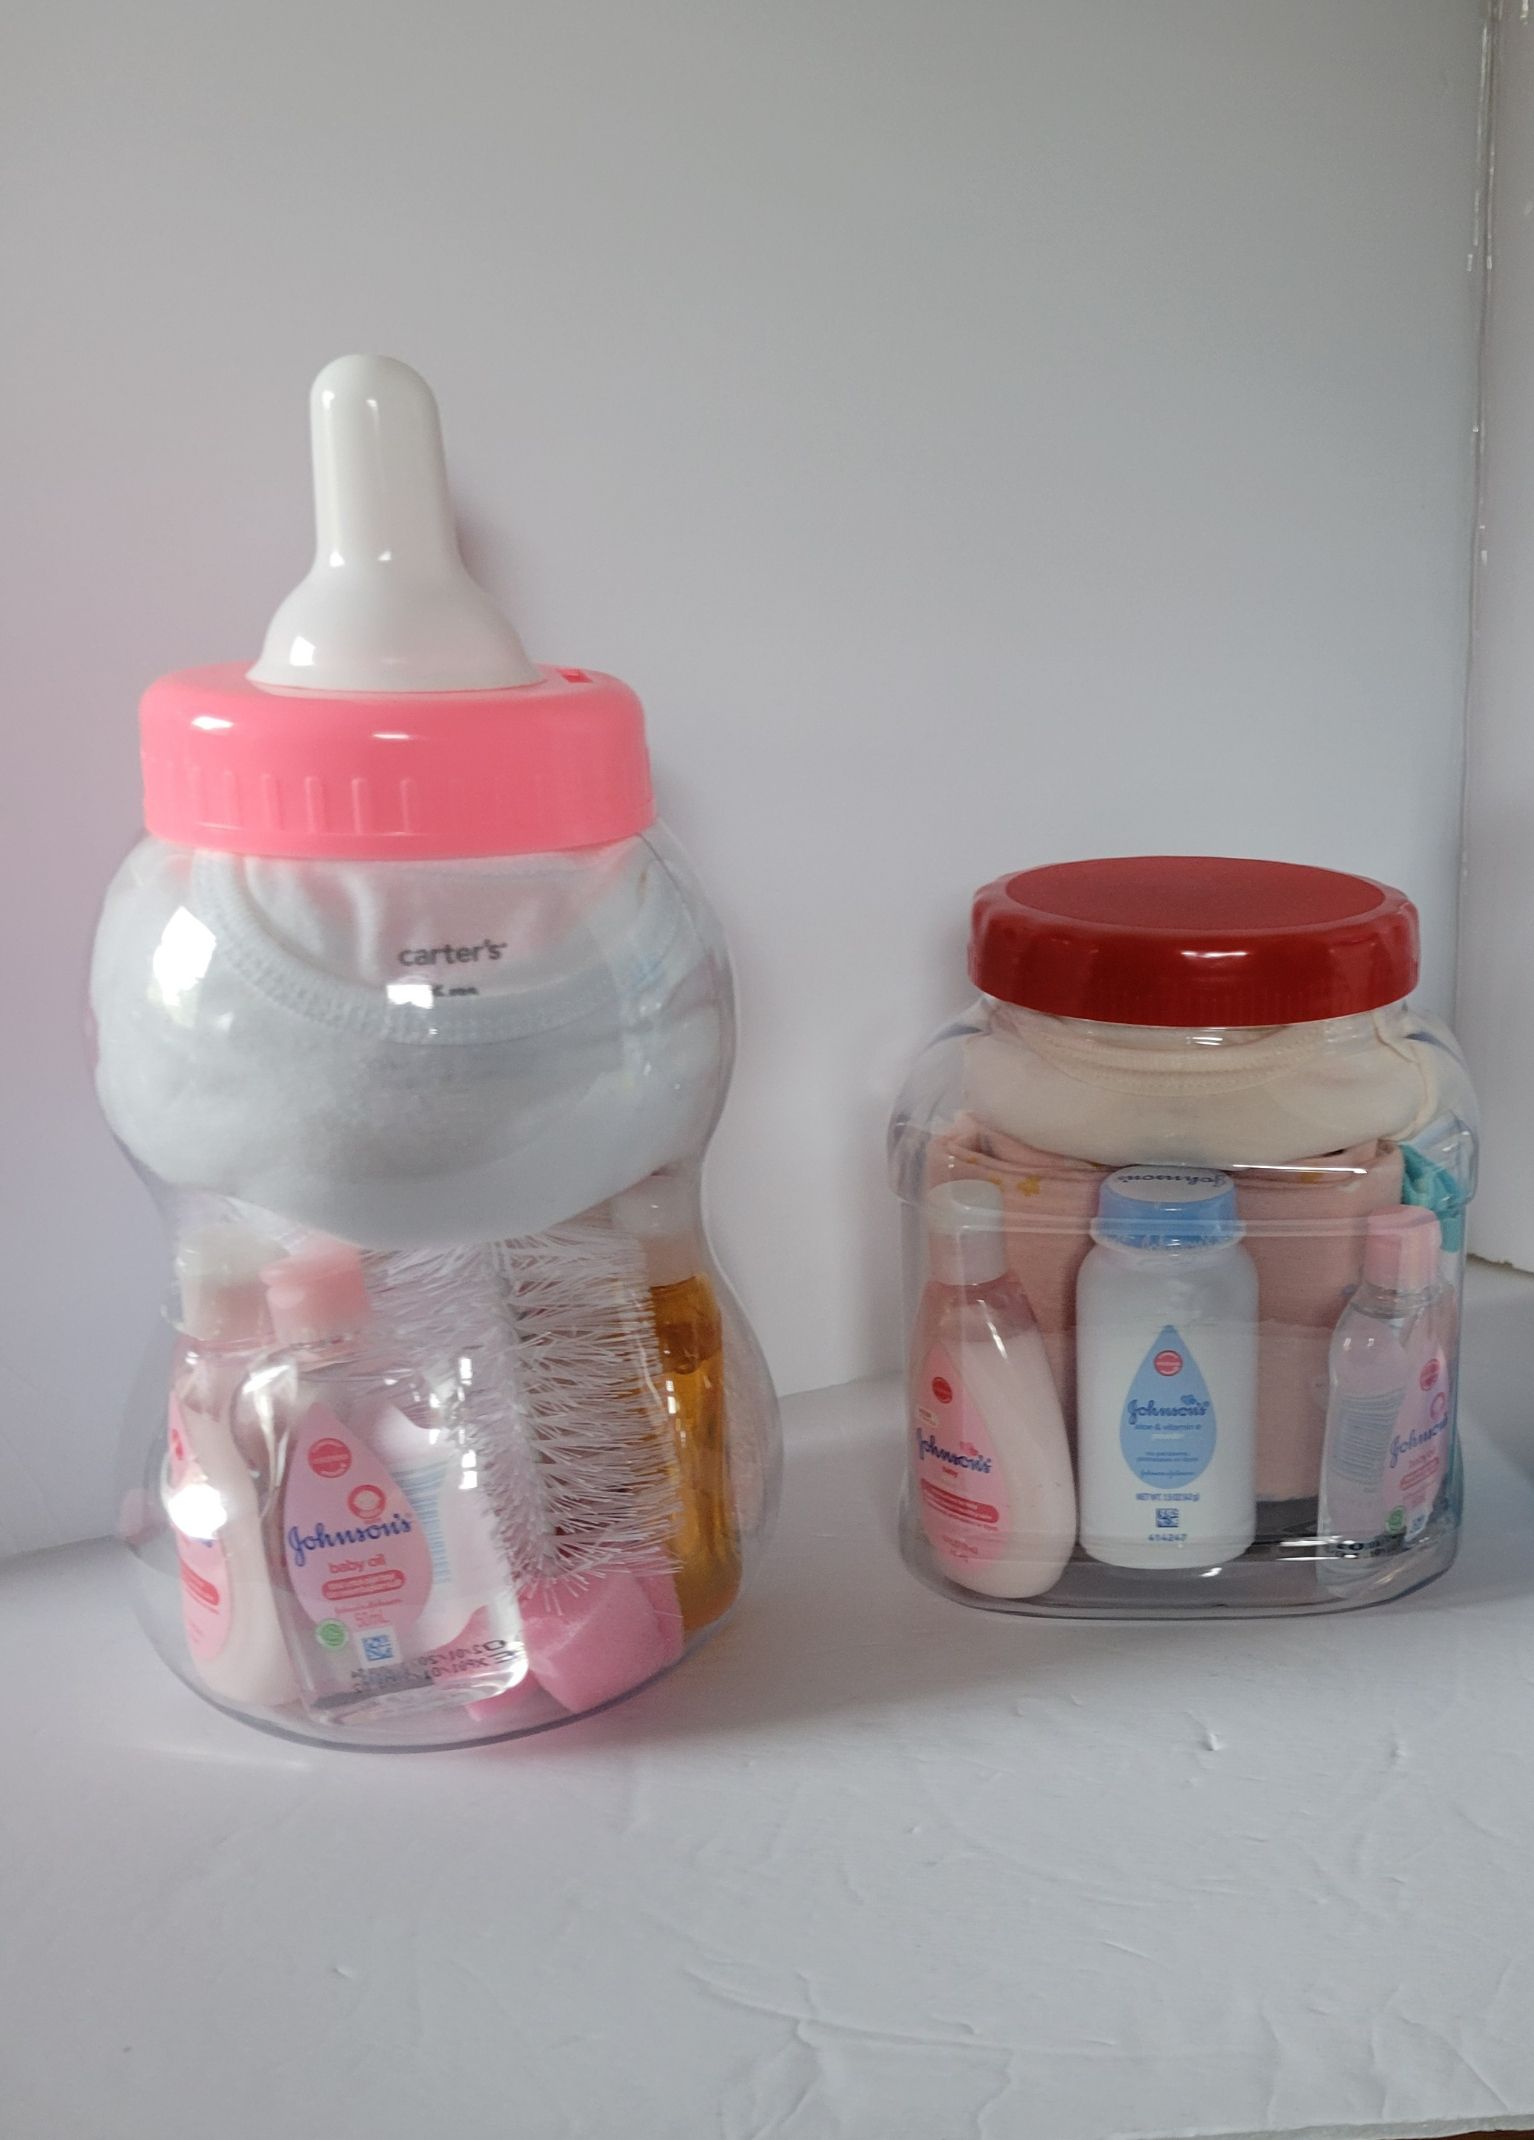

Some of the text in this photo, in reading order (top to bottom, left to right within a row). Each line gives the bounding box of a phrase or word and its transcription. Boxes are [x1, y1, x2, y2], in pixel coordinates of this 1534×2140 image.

[399, 939, 507, 967] carter's
[1117, 1173, 1227, 1188] Johnson's
[1127, 1398, 1208, 1425] Johnson's
[288, 1513, 412, 1567] Johnson's
[328, 1553, 386, 1574] baby oil
